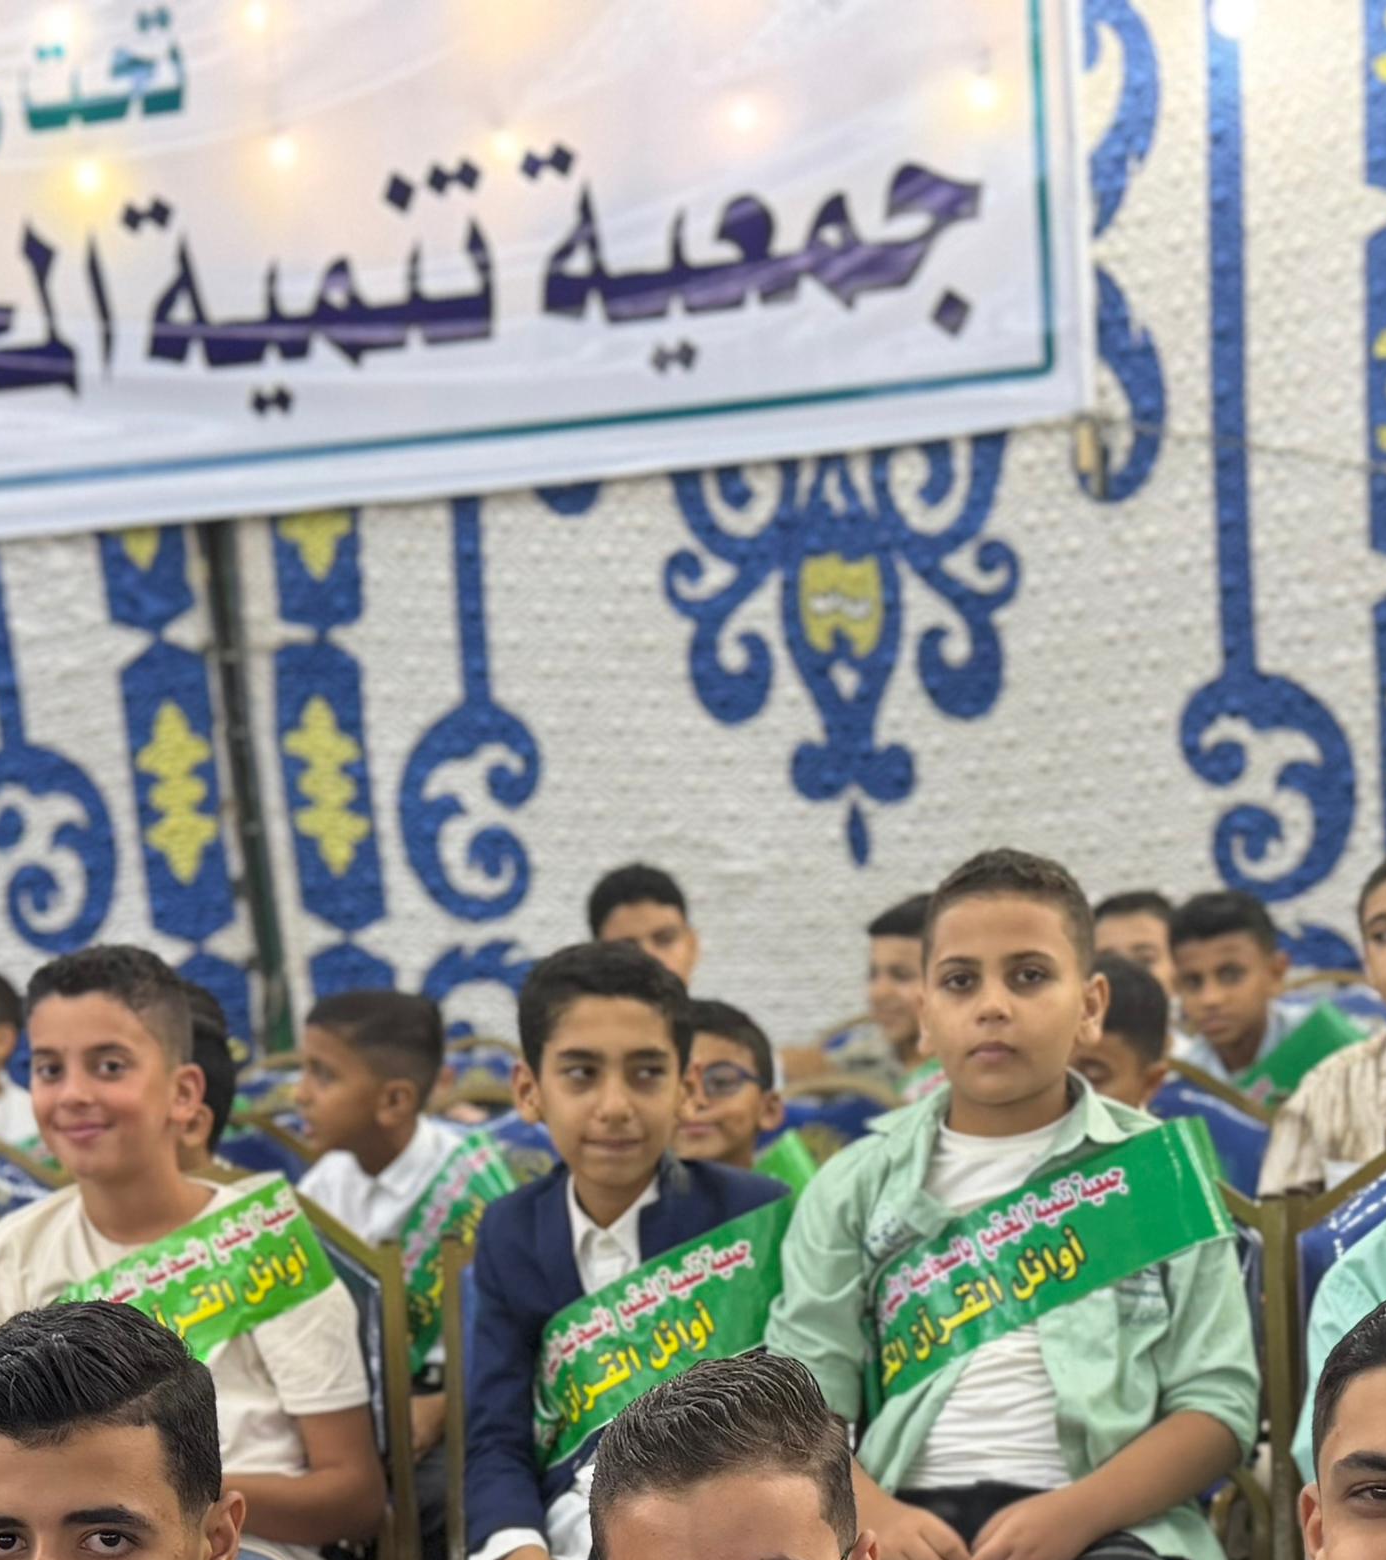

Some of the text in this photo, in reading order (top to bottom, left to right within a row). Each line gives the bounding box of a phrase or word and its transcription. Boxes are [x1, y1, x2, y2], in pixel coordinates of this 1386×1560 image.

[22, 8, 186, 131] تحت
[121, 160, 495, 415] تنمية
[539, 142, 983, 373] جمعية
[152, 1279, 236, 1339] القرآ
[1013, 1226, 1086, 1300] أوائل
[910, 1274, 1003, 1361] القرآن
